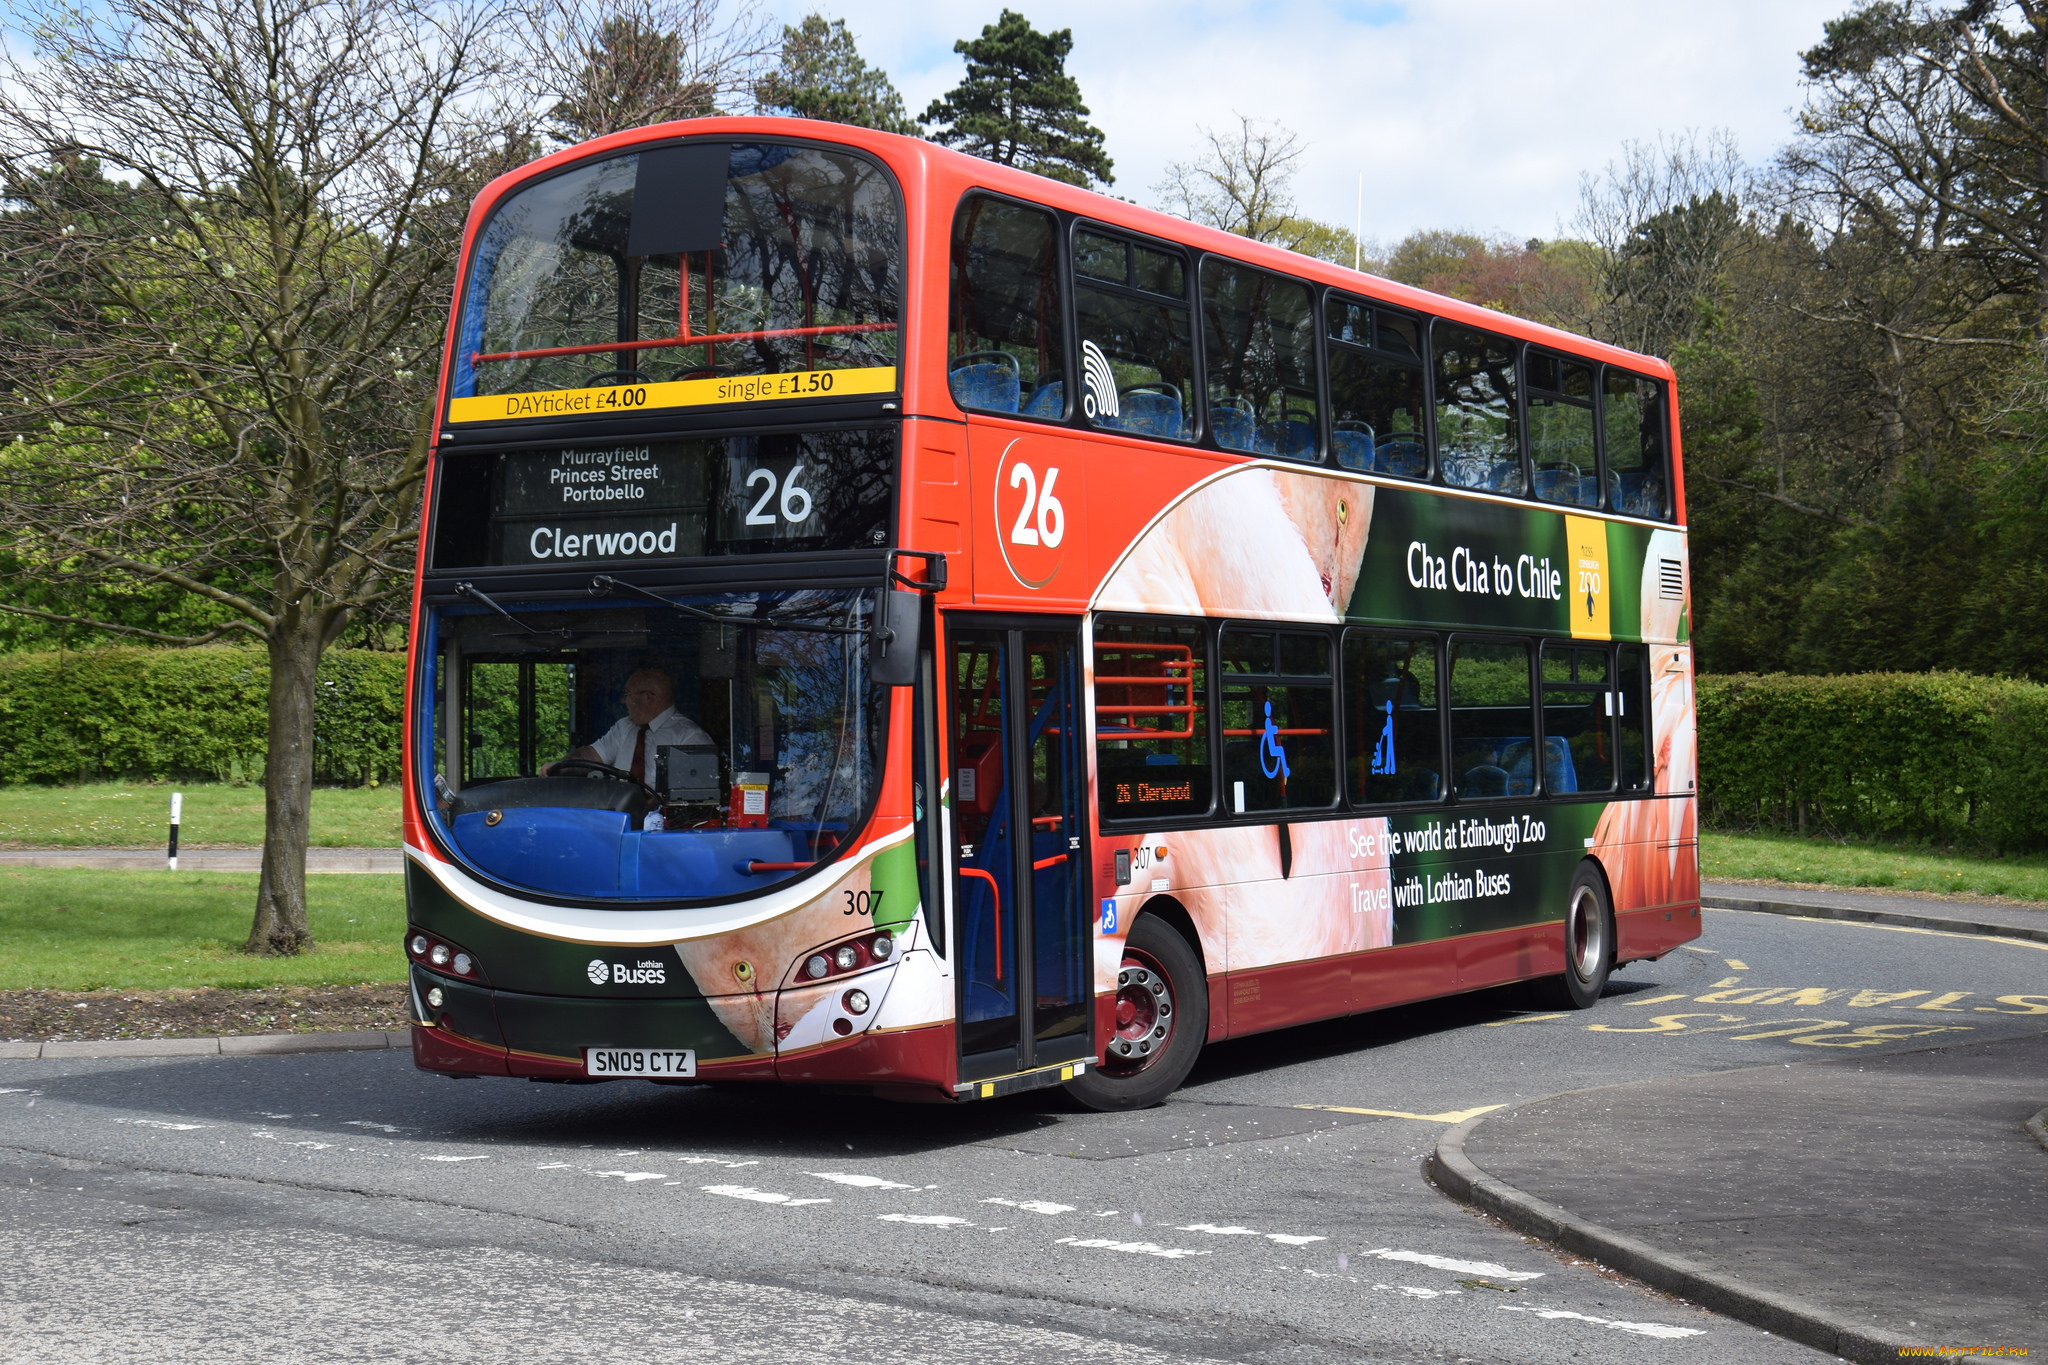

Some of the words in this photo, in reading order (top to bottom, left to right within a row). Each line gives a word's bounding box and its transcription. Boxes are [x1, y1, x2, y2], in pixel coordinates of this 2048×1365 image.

[718, 378, 772, 400] single
[779, 373, 834, 394] £1.50
[506, 392, 591, 415] DAYticket
[596, 388, 647, 409] £4.00
[561, 445, 649, 466] Murrayfield
[550, 468, 606, 484] Princes
[610, 464, 659, 482] Street
[563, 484, 645, 502] Portobello
[745, 466, 813, 527] 26
[1010, 462, 1065, 548] 26
[530, 522, 677, 559] Clerwood
[1407, 540, 1447, 590] Cha
[1451, 546, 1490, 594] Cha
[1493, 554, 1513, 597] to
[1517, 554, 1562, 601] Chile
[1578, 570, 1600, 594] ZOO
[1116, 784, 1131, 803] 26
[1137, 781, 1190, 801] Clerwood
[1350, 828, 1375, 858] See
[1379, 825, 1401, 855] the
[1404, 821, 1441, 853] world
[1444, 822, 1457, 850] at
[1460, 816, 1520, 853] Edinburgh
[1522, 815, 1546, 842] Zoo
[1134, 847, 1150, 870] 307
[843, 889, 884, 916] 307
[1351, 879, 1391, 913] Travel
[1394, 876, 1424, 908] with
[1427, 871, 1473, 904] Lothian
[1476, 869, 1511, 898] Buses
[613, 963, 666, 984] Buses
[637, 960, 664, 969] Lothian
[595, 1051, 645, 1072] SN09
[650, 1052, 688, 1072] CTZ
